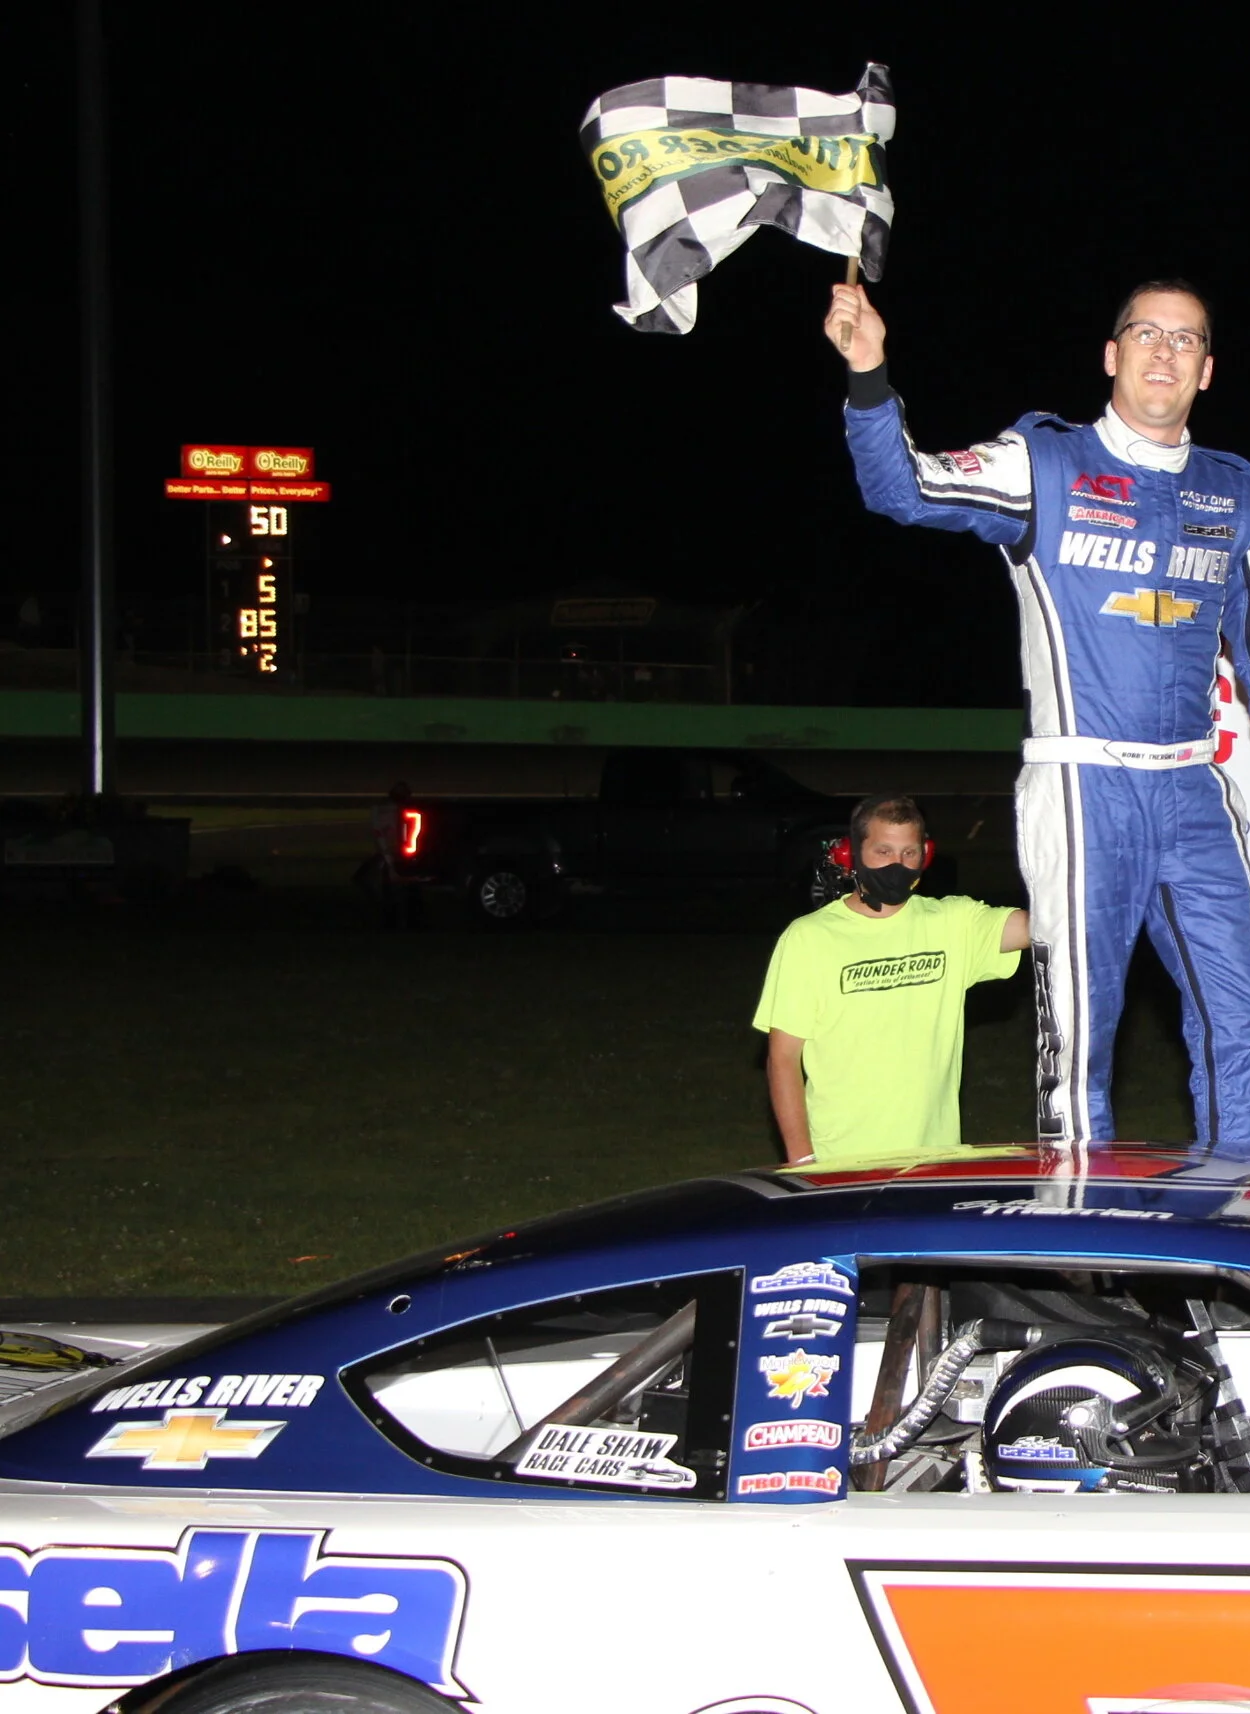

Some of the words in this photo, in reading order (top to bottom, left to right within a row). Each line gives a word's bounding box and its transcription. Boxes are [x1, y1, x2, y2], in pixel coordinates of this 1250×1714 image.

[190, 450, 241, 471] O'Reilly
[256, 451, 306, 472] O'Reilly
[1071, 472, 1137, 501] ACT
[1210, 495, 1236, 507] ONE
[250, 505, 288, 536] 50
[1059, 530, 1157, 575] WELLS
[1165, 545, 1230, 584] RIVER
[259, 574, 276, 603] 5
[240, 608, 277, 638] 85
[846, 961, 907, 981] THUNDER
[908, 957, 941, 973] ROAD
[754, 1299, 803, 1318] WELLS
[802, 1298, 847, 1317] RIVER
[761, 1354, 839, 1369] Maplewood
[91, 1375, 212, 1413] WELLS
[204, 1374, 325, 1407] RIVER
[538, 1429, 598, 1454] DALE
[596, 1434, 670, 1460] SHAW
[750, 1424, 838, 1446] CHAMPEAU
[524, 1452, 571, 1473] RACE
[574, 1456, 626, 1477] CARS
[740, 1475, 783, 1492] PRO
[788, 1475, 838, 1492] HEAT
[0, 1531, 460, 1687] ella
